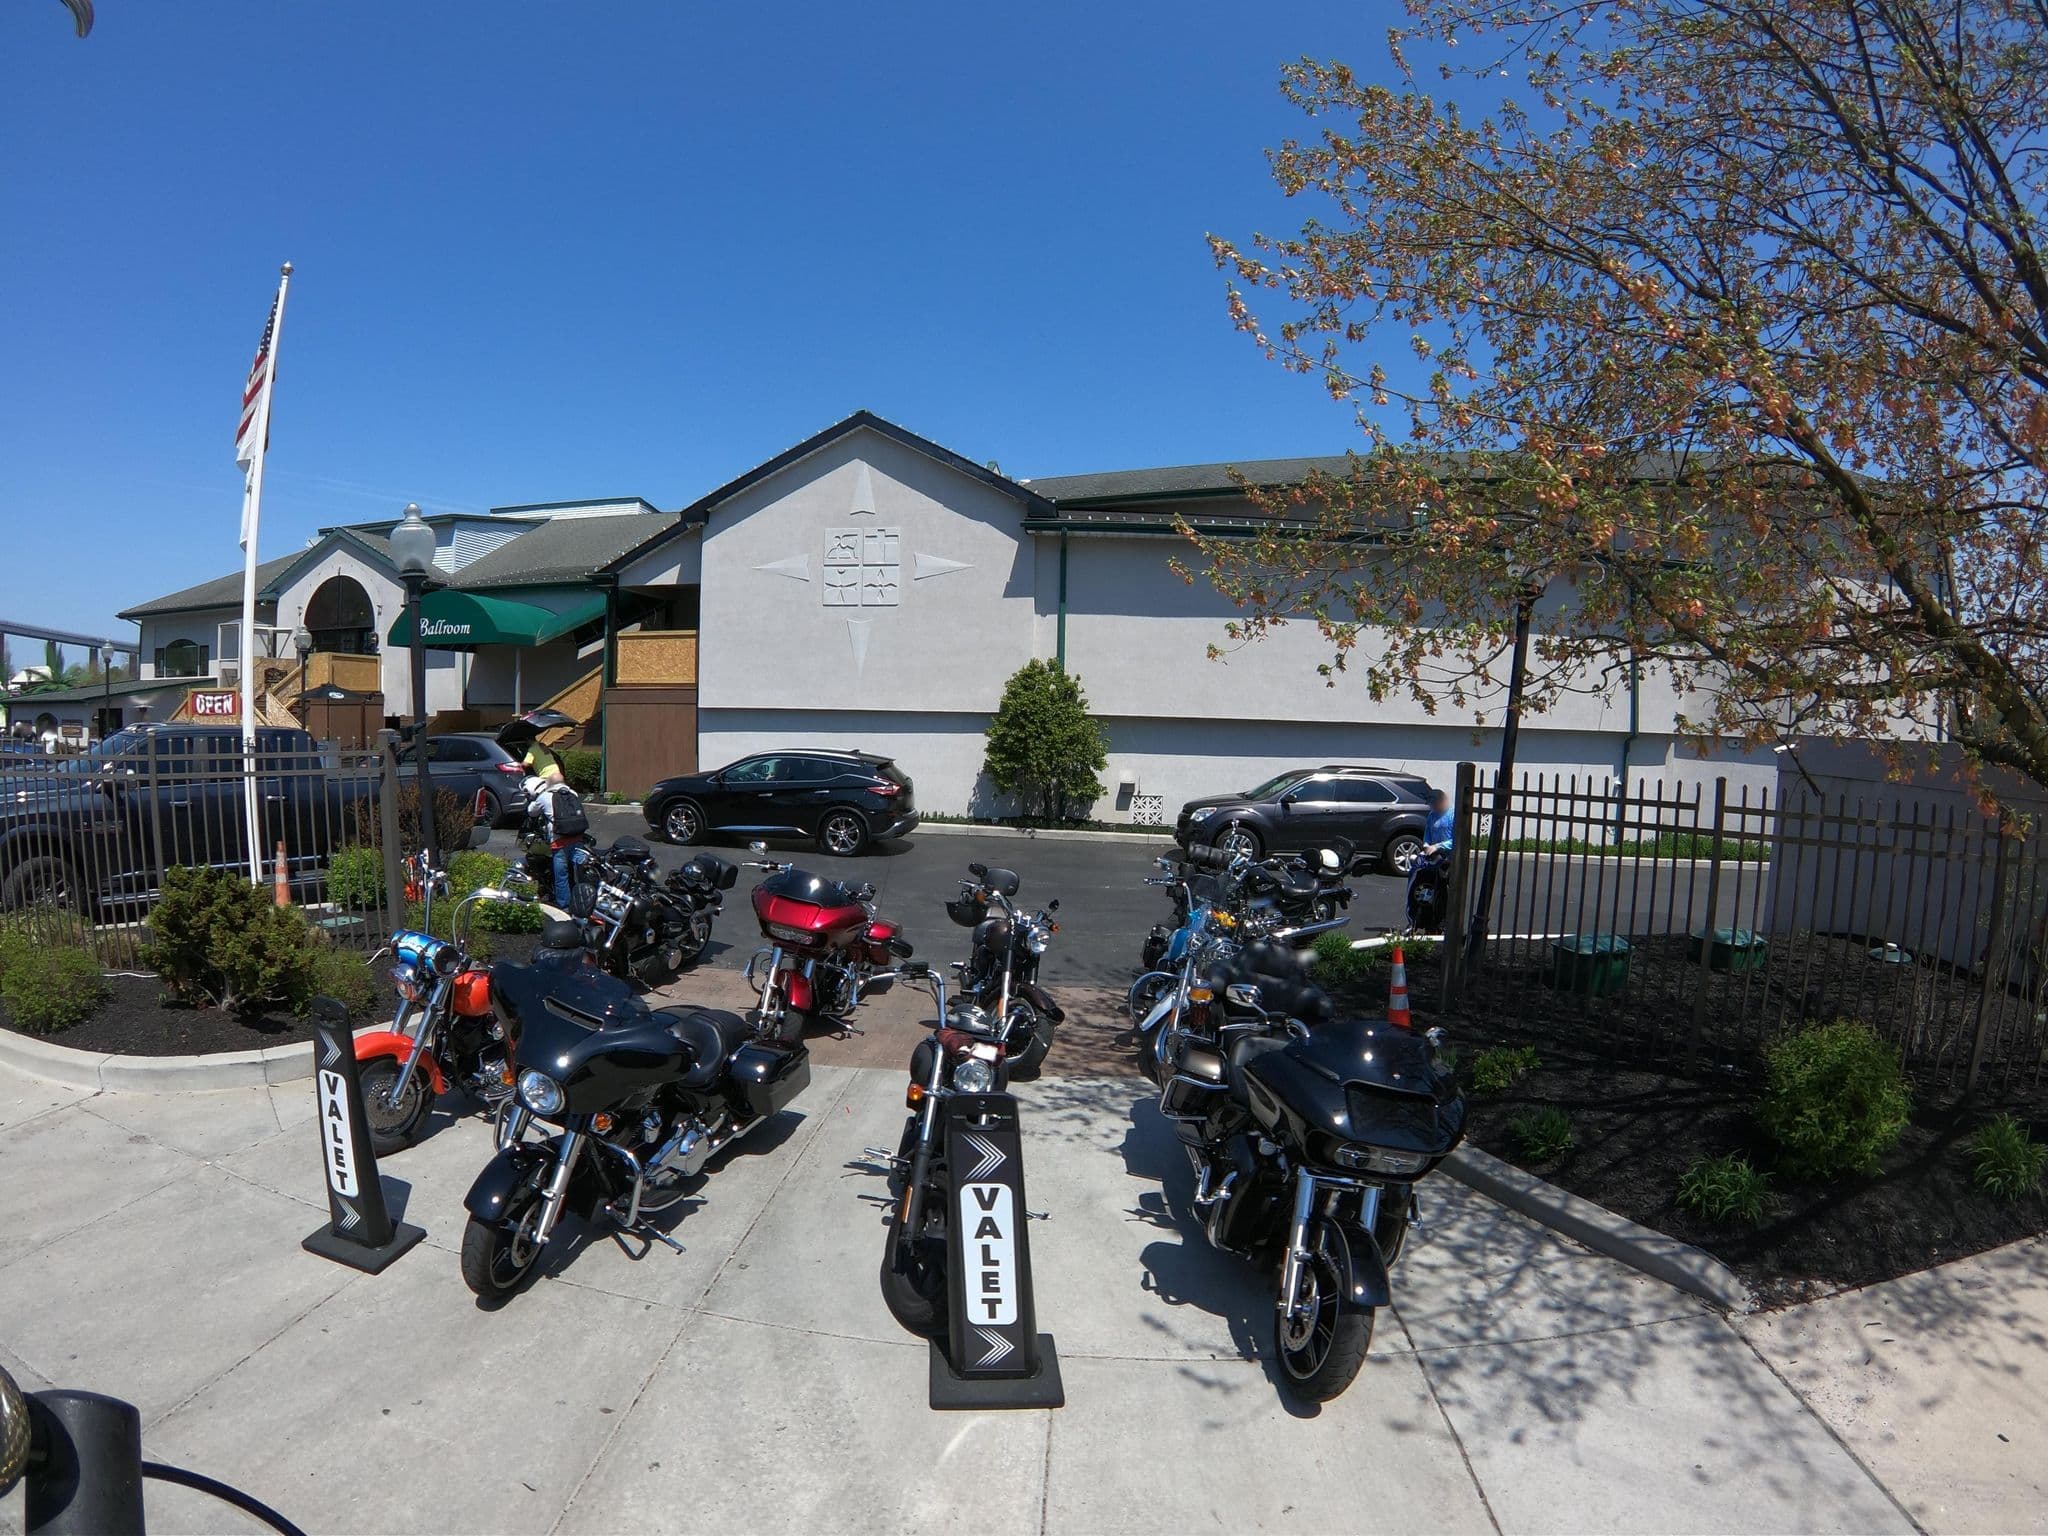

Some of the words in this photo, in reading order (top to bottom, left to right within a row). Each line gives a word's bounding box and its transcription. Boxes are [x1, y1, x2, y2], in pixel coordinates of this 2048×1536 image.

[420, 617, 470, 637] Ballroom
[196, 693, 233, 715] OPEN
[325, 1073, 349, 1190] VALET
[972, 1187, 1003, 1319] VALET
